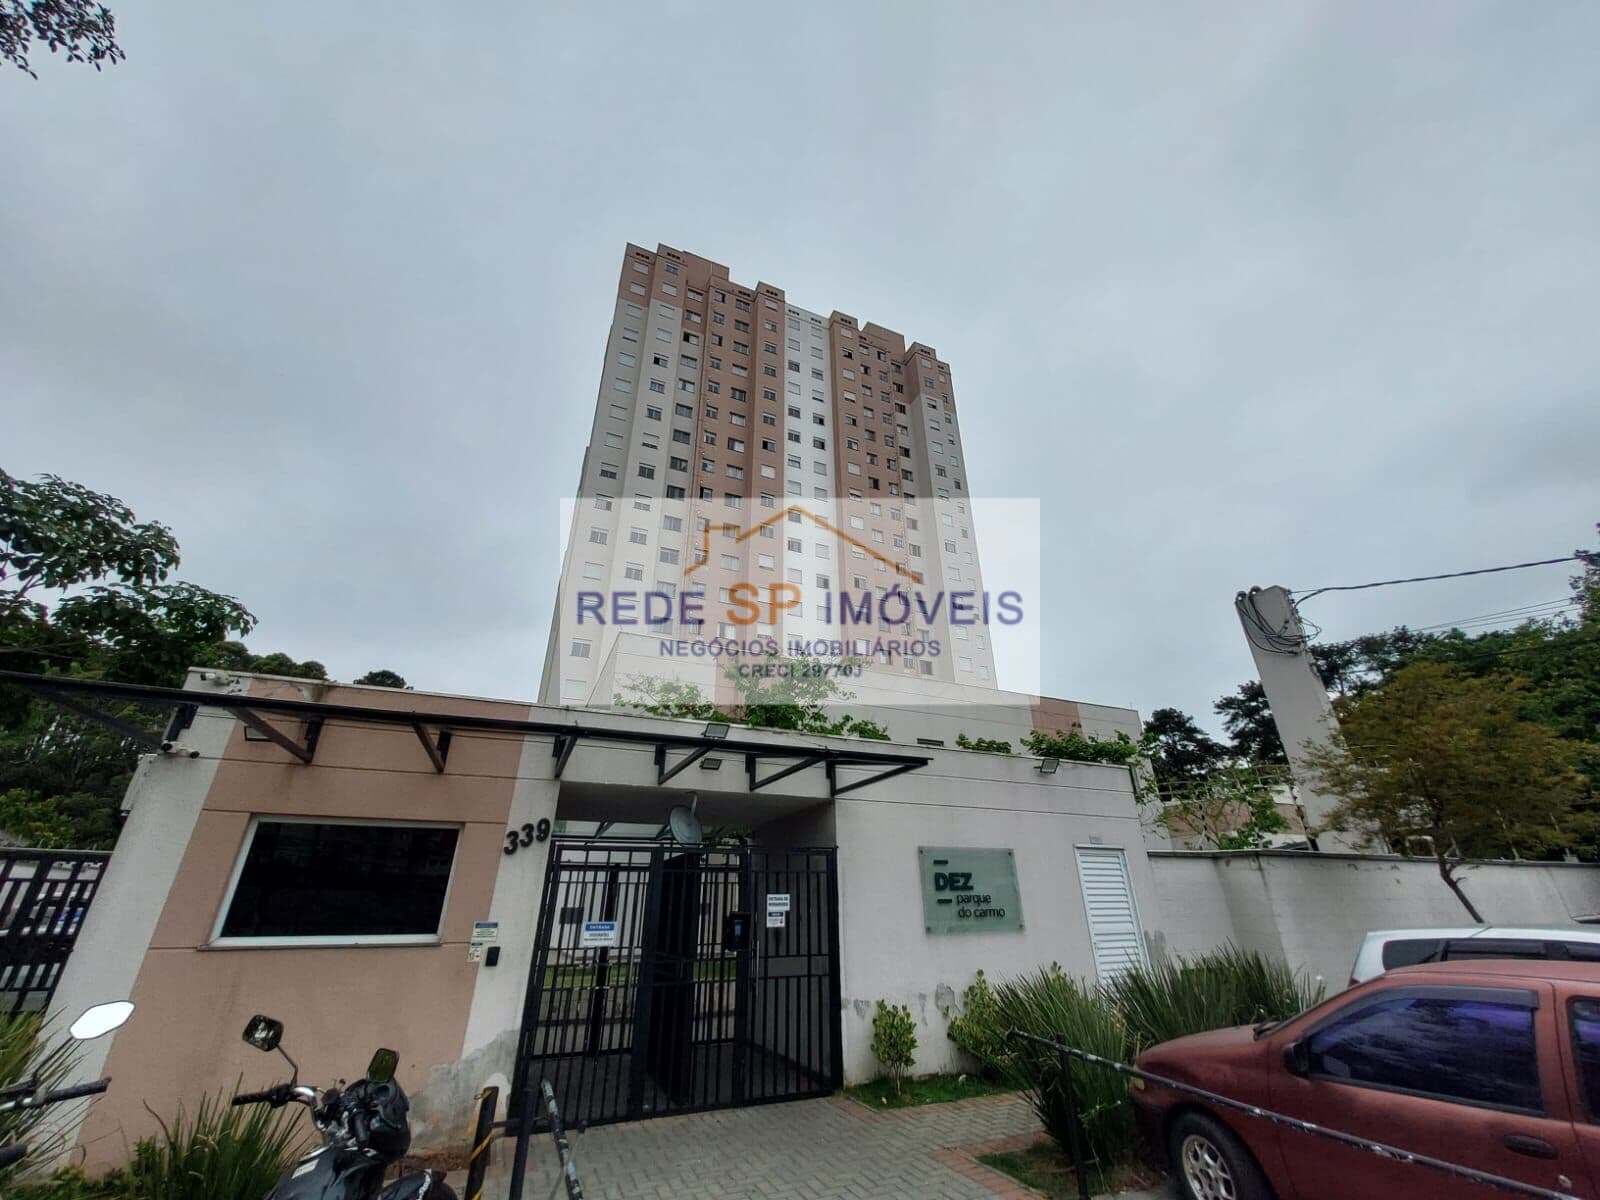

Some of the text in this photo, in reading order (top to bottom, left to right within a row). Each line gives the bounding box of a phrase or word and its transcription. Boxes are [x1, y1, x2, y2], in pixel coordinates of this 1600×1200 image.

[503, 817, 551, 856] 339
[934, 872, 974, 892] DEZ
[956, 894, 992, 907] parque
[958, 906, 1006, 919] do carmo
